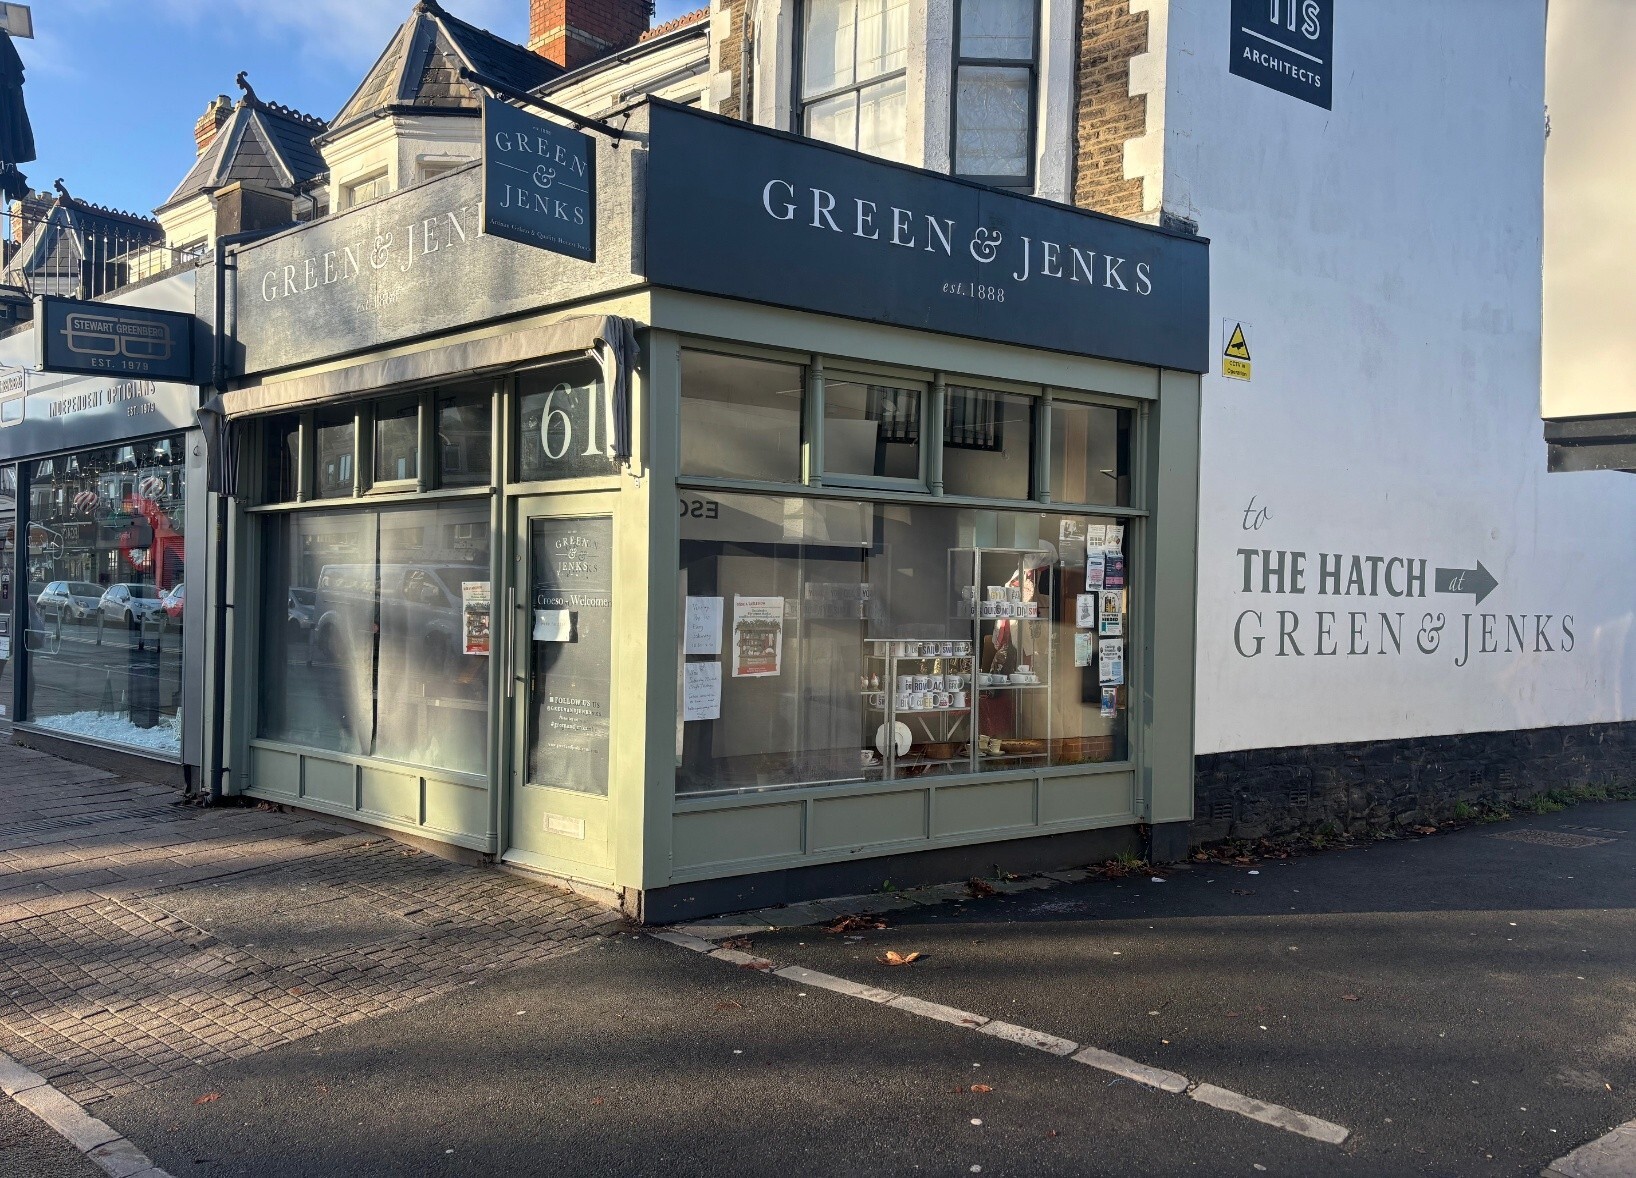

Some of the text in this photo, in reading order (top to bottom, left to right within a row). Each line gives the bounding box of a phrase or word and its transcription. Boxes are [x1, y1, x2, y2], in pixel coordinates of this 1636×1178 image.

[1243, 46, 1321, 88] ARCHITECTS
[495, 131, 587, 178] GREEN
[533, 164, 556, 189] &
[500, 183, 584, 225] JENKS
[762, 179, 1152, 296] GREEN & JENKS
[261, 241, 362, 302] GREEN
[369, 231, 393, 269] &
[74, 319, 164, 338] STEWART GREENBERG
[91, 358, 149, 371] EST. 1979
[49, 380, 156, 418] INDEPENDENT OPTICIANS
[127, 402, 156, 417] EST. 1979
[541, 378, 603, 460] 61
[556, 562, 588, 573] JENKS
[1236, 548, 1466, 598] THE HATCH at
[538, 594, 564, 606] Croeso
[570, 594, 609, 606] Welcome
[1233, 609, 1575, 667] GREEN & JENKS
